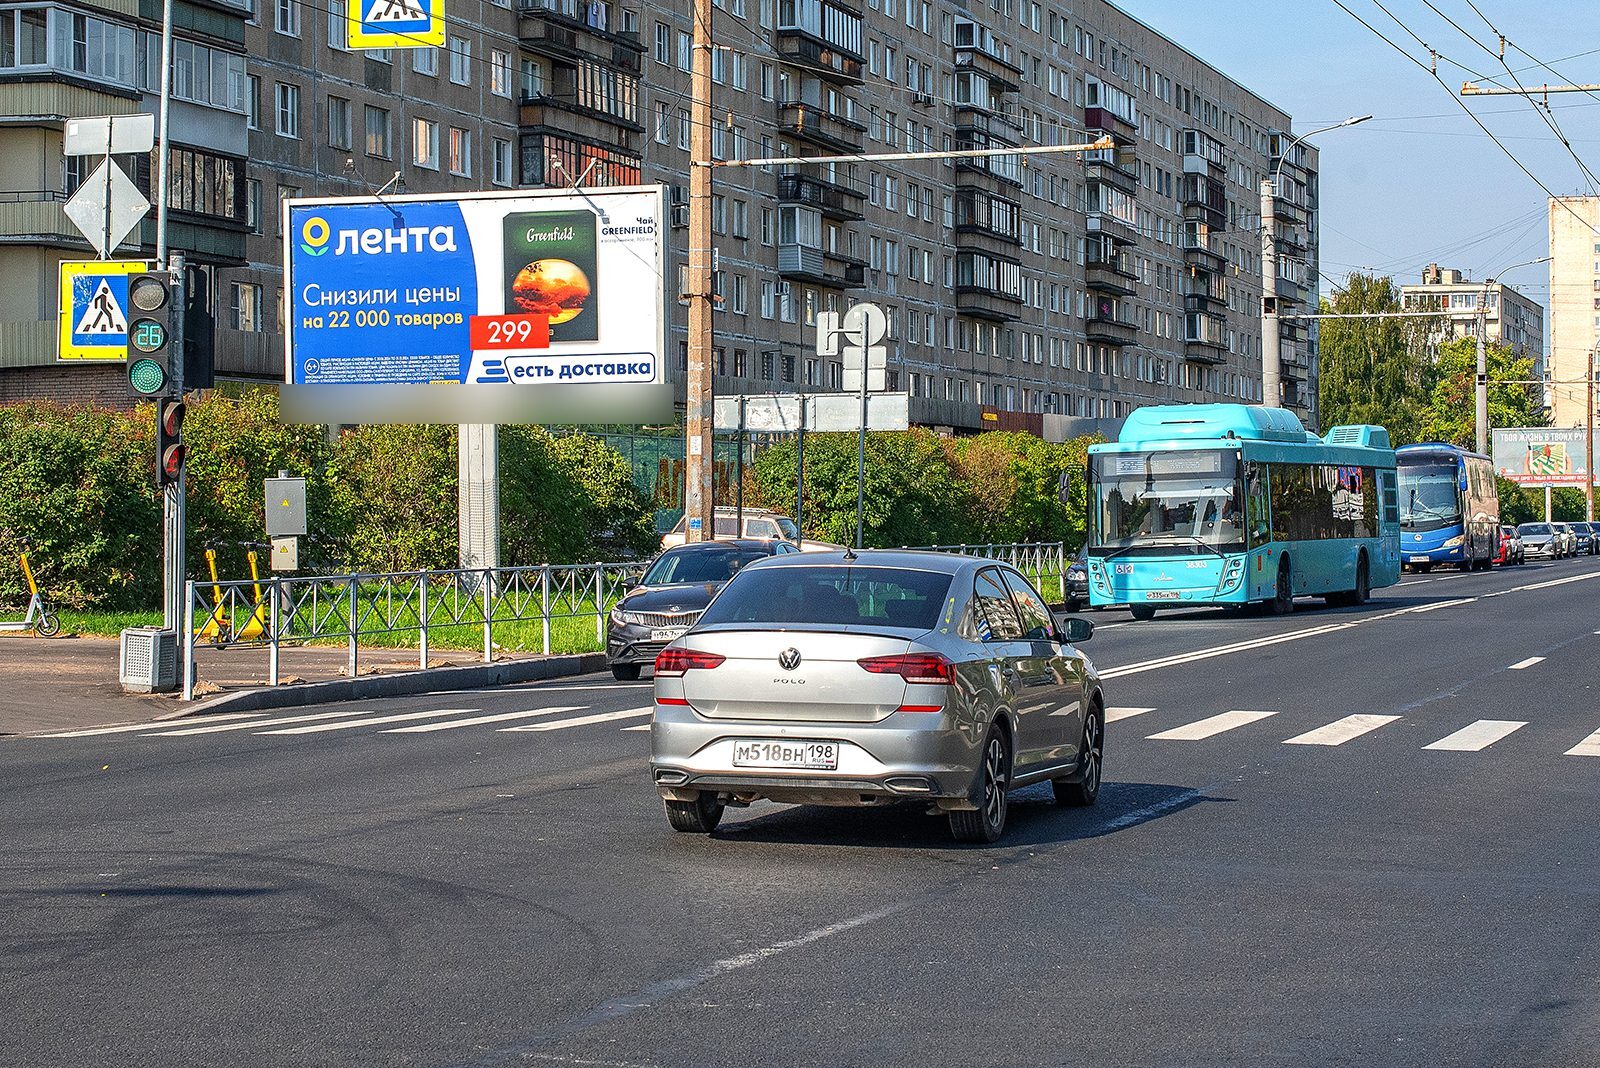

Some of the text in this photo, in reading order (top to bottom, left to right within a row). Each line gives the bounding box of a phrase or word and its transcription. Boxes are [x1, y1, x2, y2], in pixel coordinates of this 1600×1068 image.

[636, 216, 654, 225] Чай
[335, 224, 457, 256] лента
[526, 226, 575, 243] Greenfield
[602, 226, 654, 236] GREENFIELD
[302, 283, 460, 307] Снизили цены
[303, 309, 464, 330] на 22 000 товаров
[137, 324, 160, 346] 26
[487, 320, 532, 344] 299
[307, 361, 317, 370] 6+
[513, 361, 651, 380] есть доставка
[1501, 433, 1518, 442] ТВОЯ
[1520, 433, 1543, 442] ЖИЗНЬ
[1544, 432, 1550, 441] В
[1551, 432, 1573, 441] ТВОИХ
[738, 743, 833, 762] М518ВН 198
